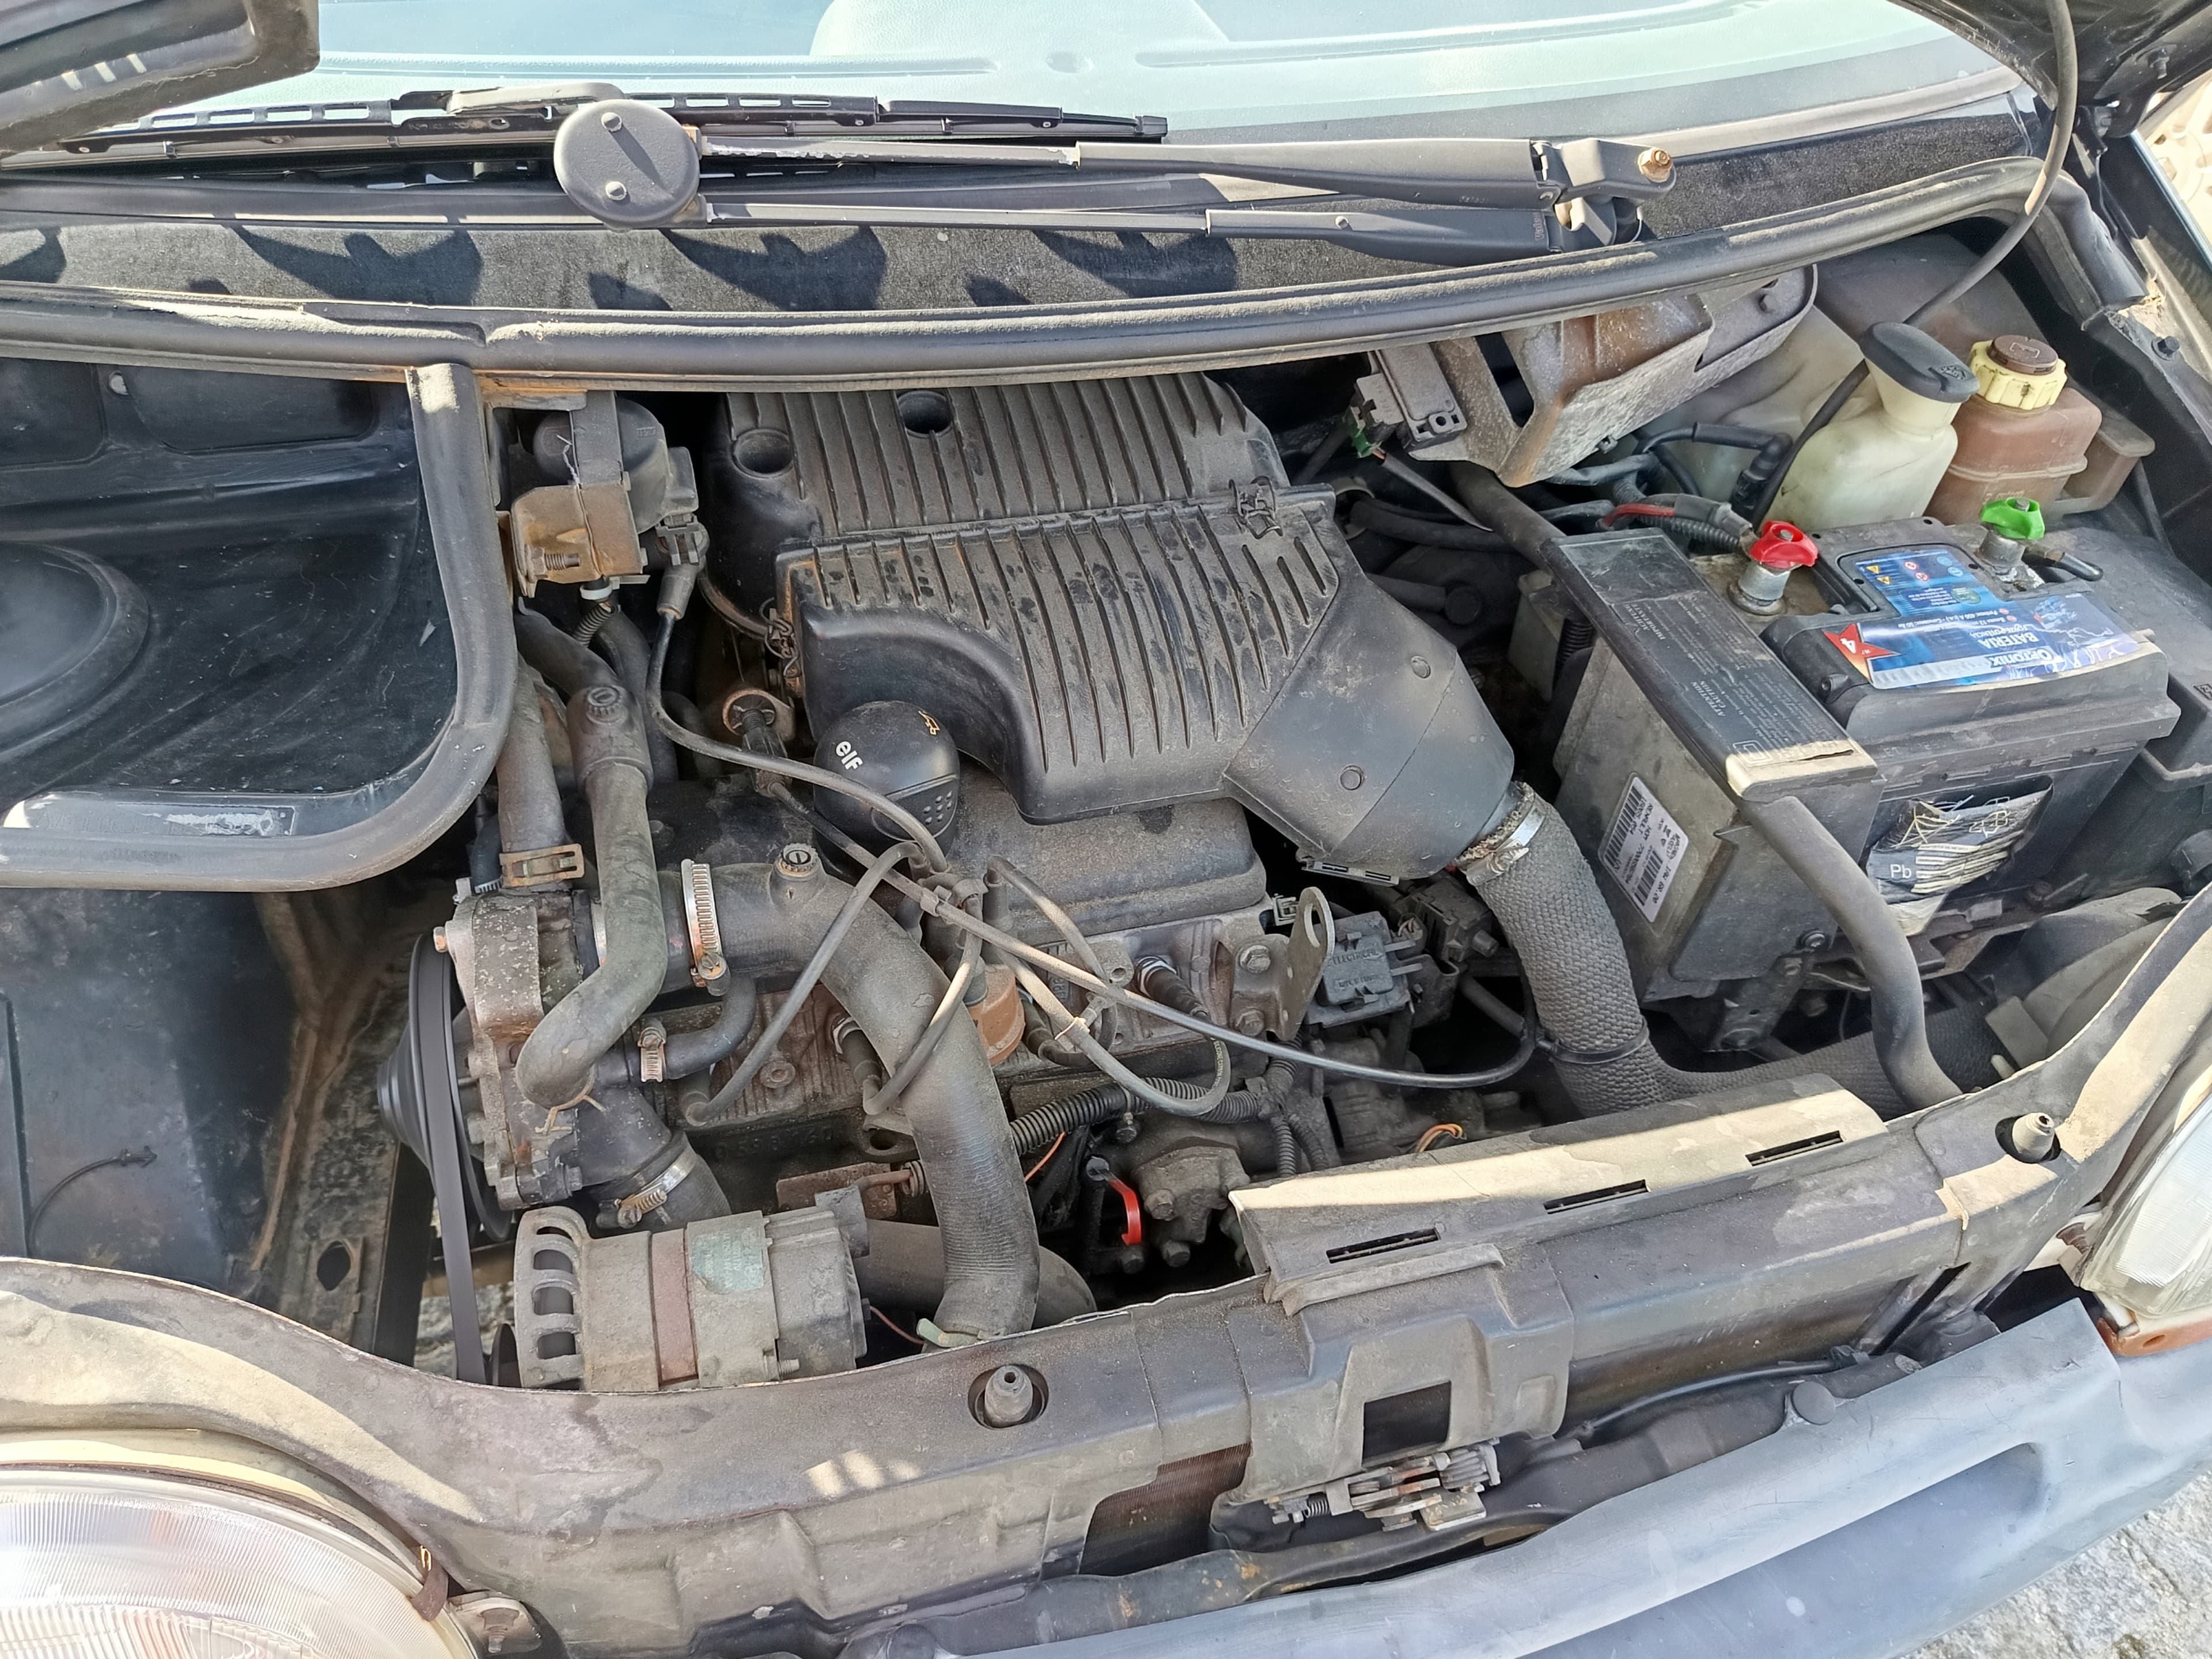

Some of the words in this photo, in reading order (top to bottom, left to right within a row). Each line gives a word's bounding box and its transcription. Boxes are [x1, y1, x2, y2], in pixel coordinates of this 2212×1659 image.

[1840, 638, 1856, 653] 4
[1978, 632, 2039, 649] BATERIA
[1691, 682, 1725, 717] ATTENTION
[1699, 681, 1726, 708] CAUTION
[836, 741, 863, 770] elf
[1638, 803, 1653, 834] RENAULT
[1890, 864, 1911, 878] Pb
